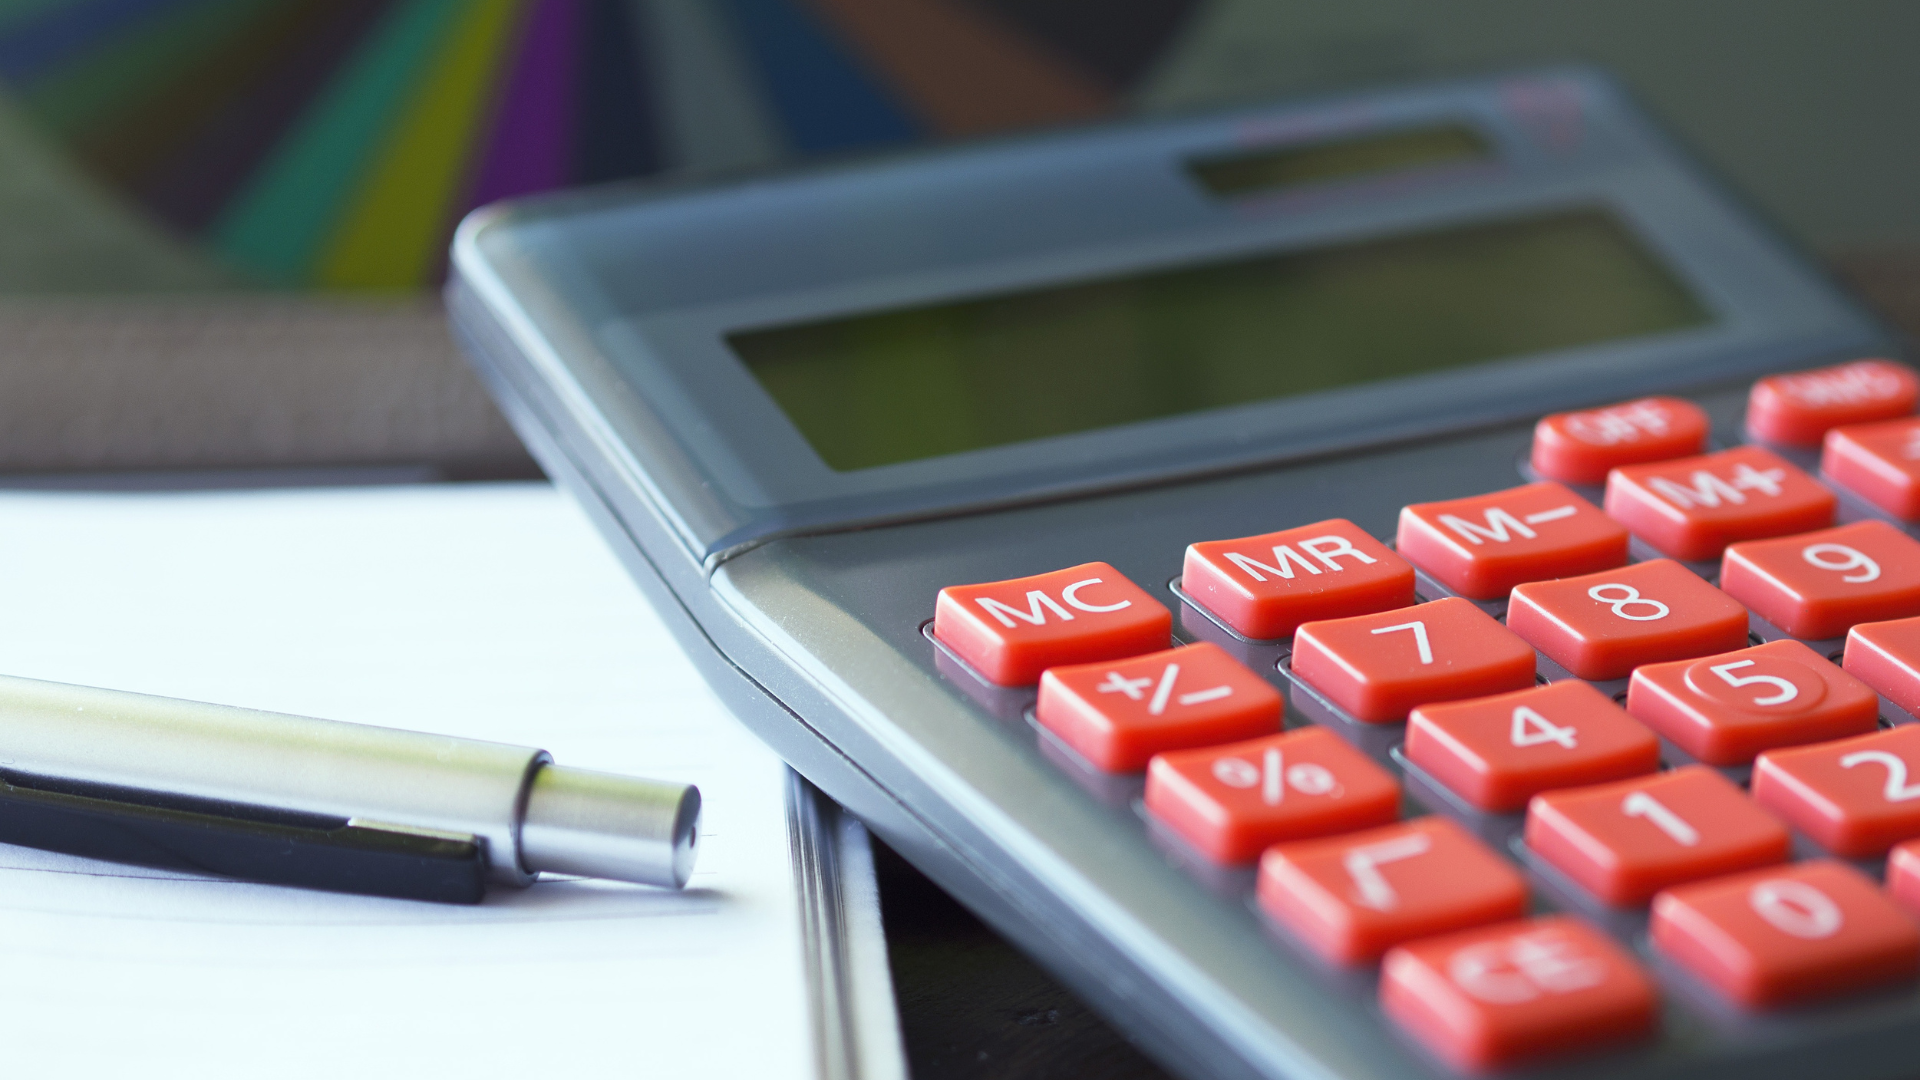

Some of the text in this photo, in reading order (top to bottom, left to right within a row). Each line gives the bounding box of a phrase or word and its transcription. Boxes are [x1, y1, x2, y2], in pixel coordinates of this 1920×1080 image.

[1646, 463, 1786, 511] M+
[1437, 505, 1577, 545] M-
[1223, 534, 1378, 582] MR
[1802, 543, 1881, 583] 9
[975, 577, 1132, 629] MC
[1587, 583, 1670, 621] 8
[1370, 620, 1434, 665] 7
[1096, 662, 1233, 716] +/-
[1709, 659, 1798, 706] 5
[1510, 705, 1576, 749] 4
[1210, 747, 1338, 806] %
[1840, 751, 1920, 801] 2
[1623, 791, 1697, 846] 1
[1749, 880, 1841, 938] 0
